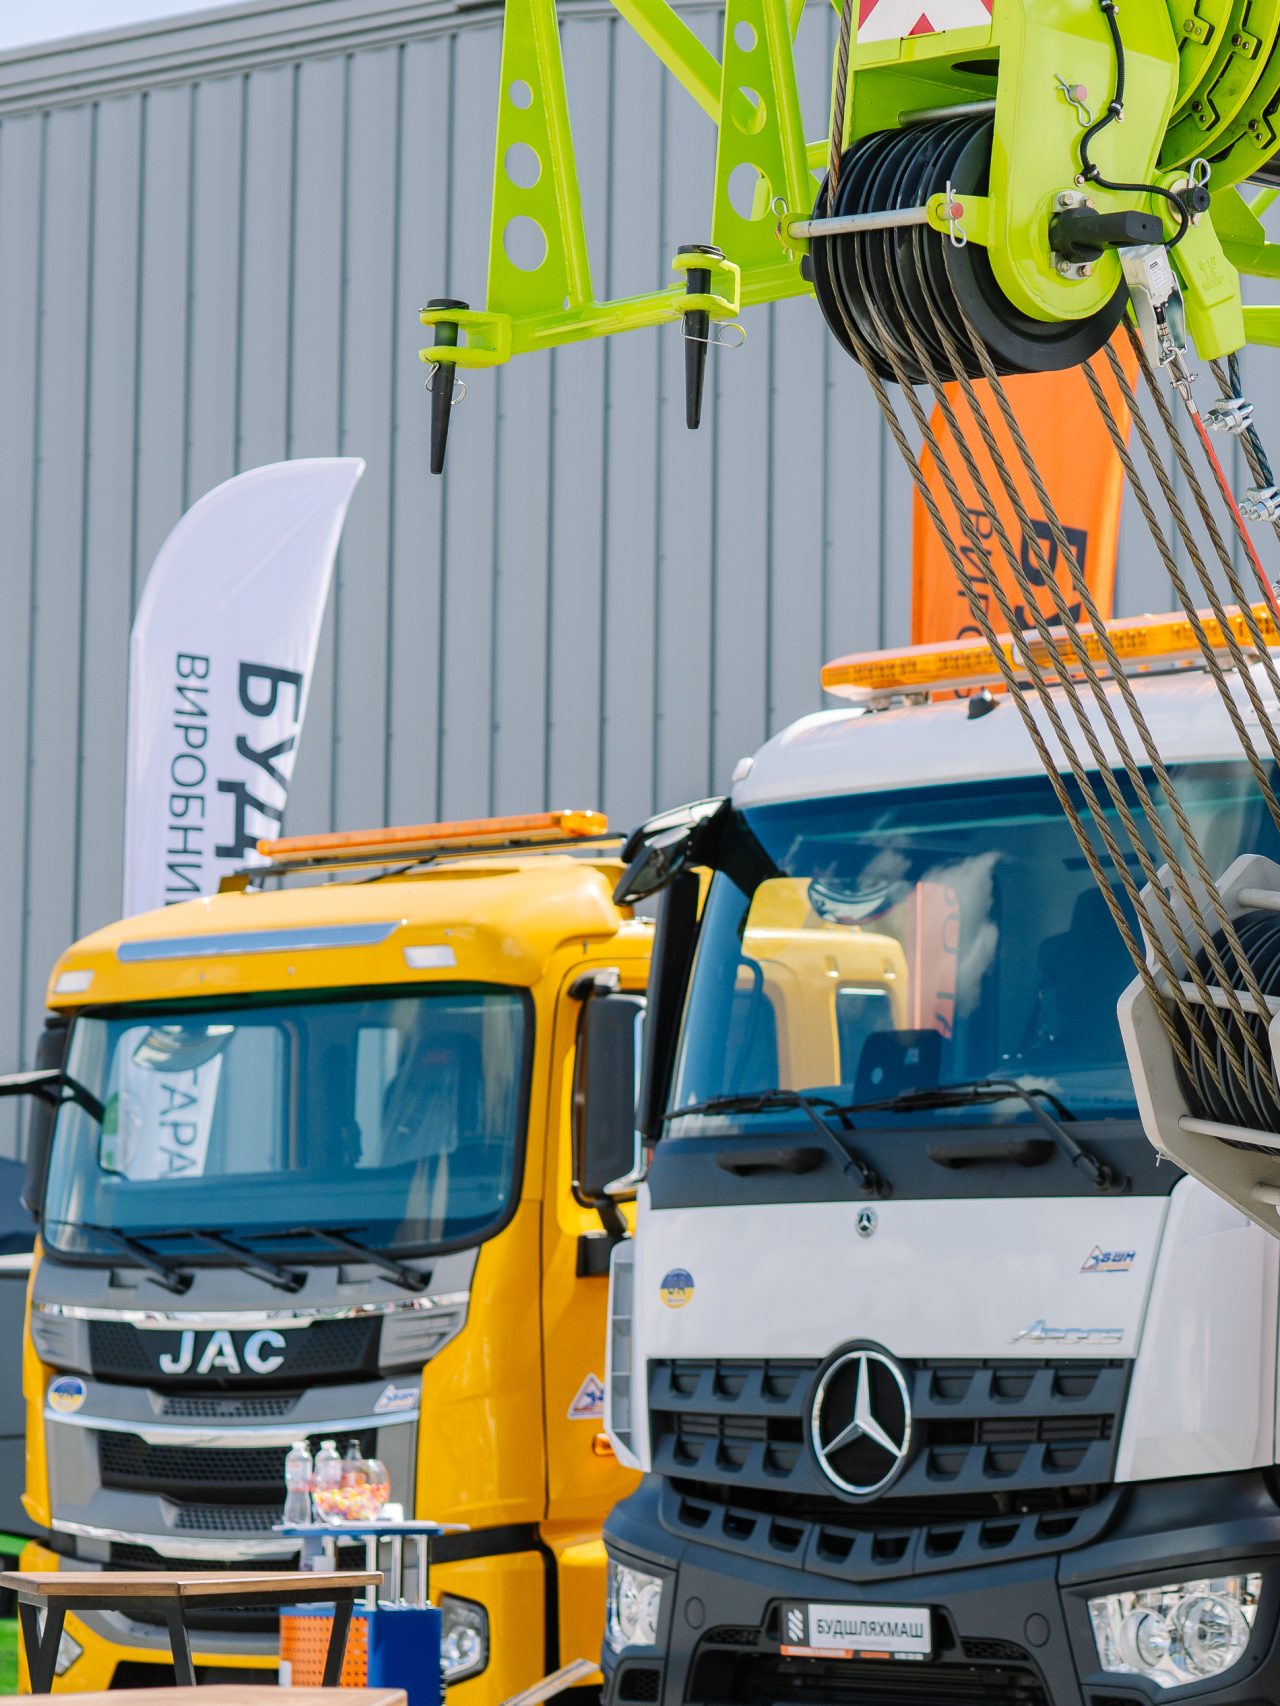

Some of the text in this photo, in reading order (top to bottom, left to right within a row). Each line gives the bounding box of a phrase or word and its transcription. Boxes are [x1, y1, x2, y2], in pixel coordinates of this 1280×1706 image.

[164, 652, 210, 907] ВИРОБНИ
[159, 1329, 287, 1374] JAC
[816, 1618, 924, 1640] БУДШЛЯХМАШ
